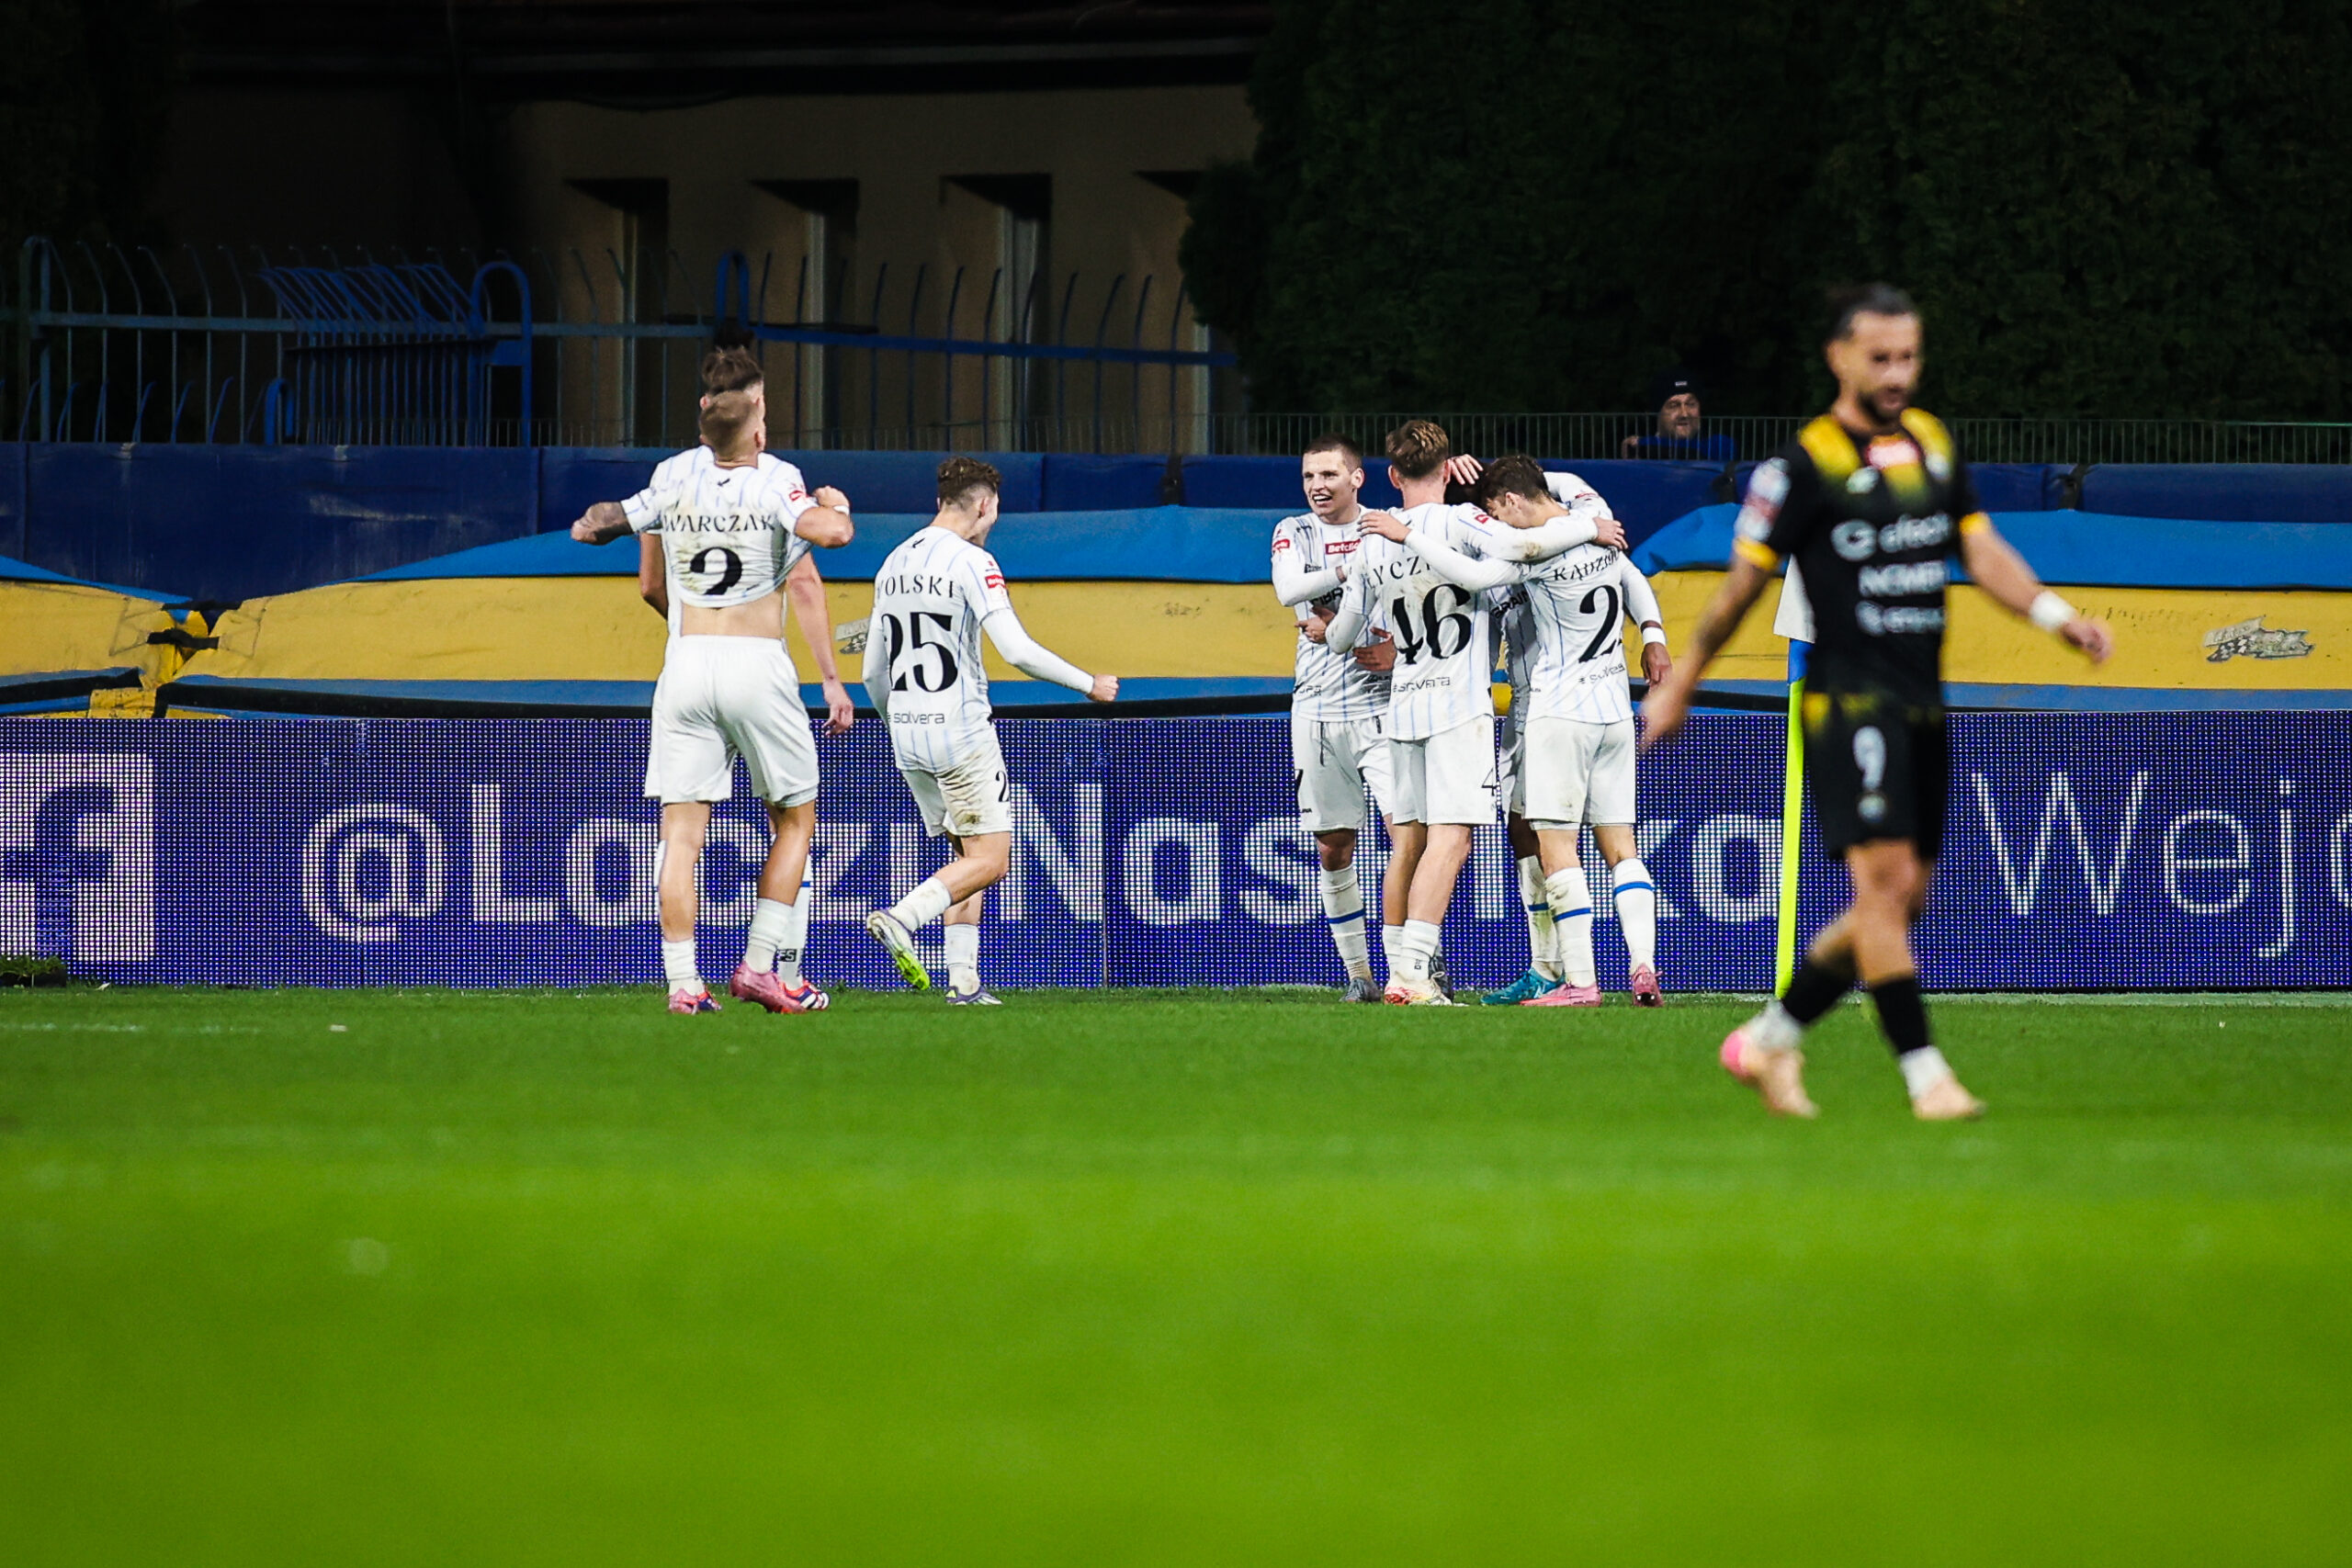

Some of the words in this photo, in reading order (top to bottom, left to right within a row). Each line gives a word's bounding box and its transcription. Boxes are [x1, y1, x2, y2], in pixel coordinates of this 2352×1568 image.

[881, 612, 958, 693] 25
[893, 712, 945, 724] solvera
[1851, 725, 1887, 790] 9
